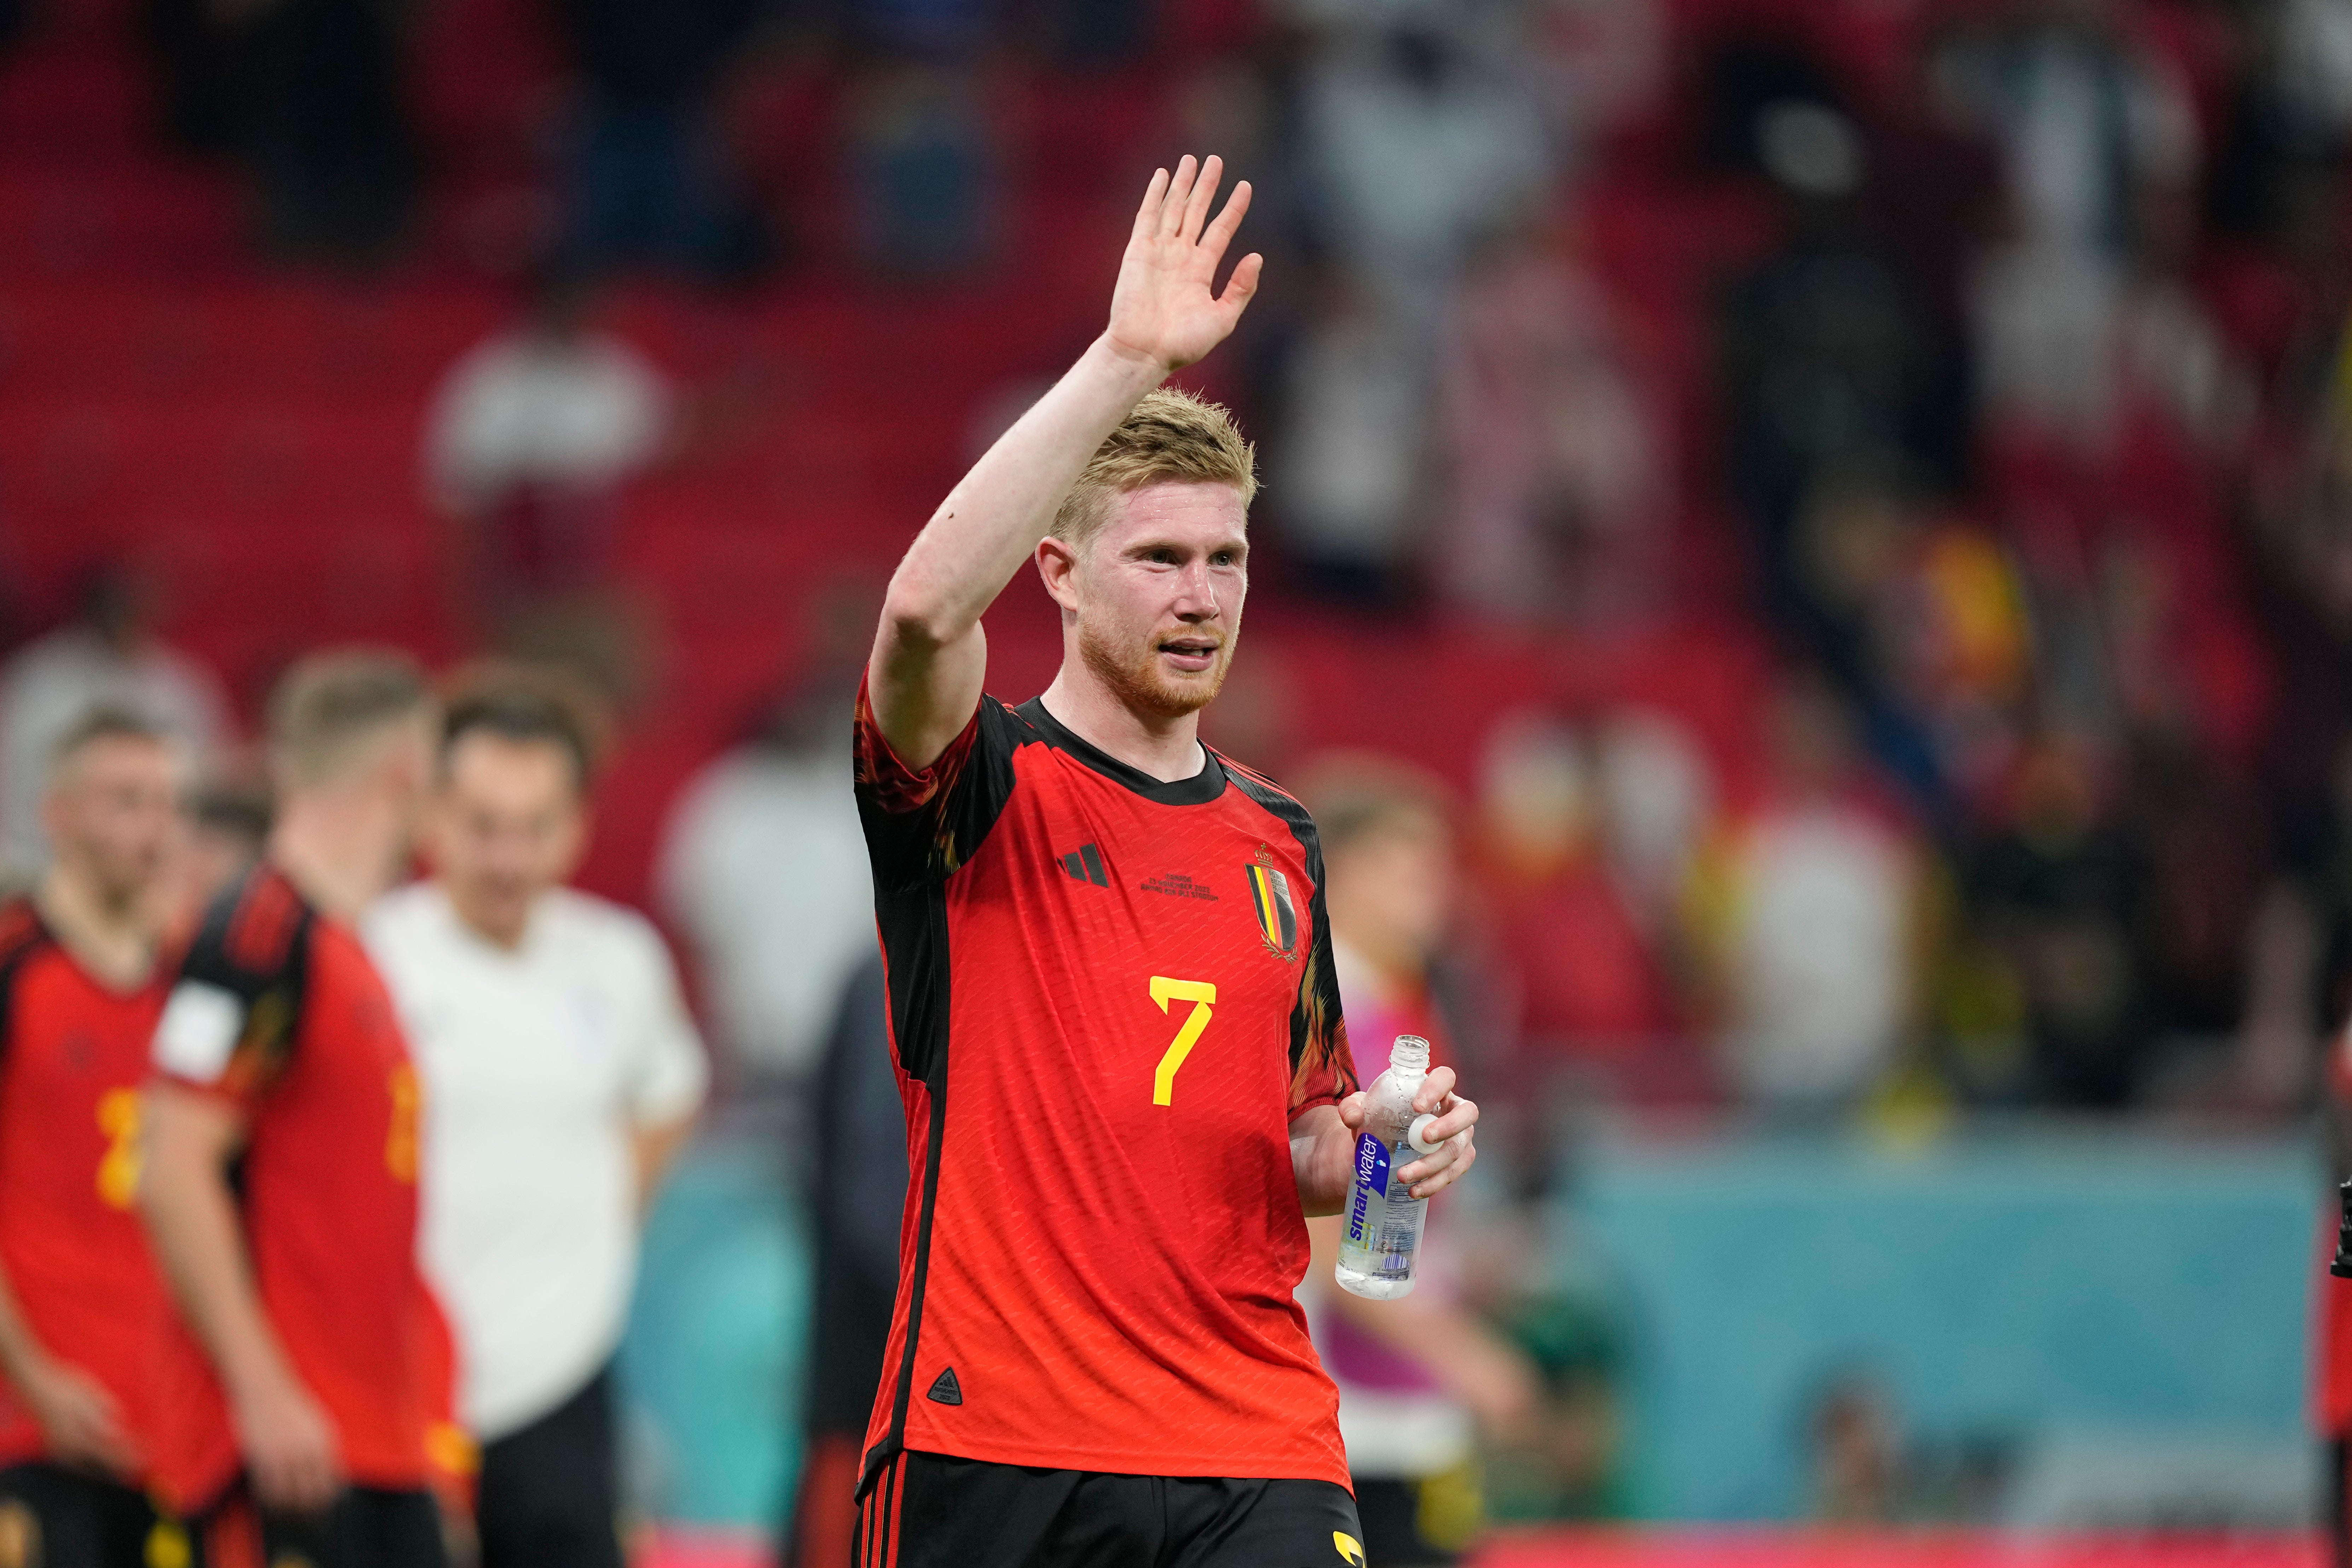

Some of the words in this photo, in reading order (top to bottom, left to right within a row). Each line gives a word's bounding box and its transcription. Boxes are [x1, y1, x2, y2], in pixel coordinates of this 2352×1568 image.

[1166, 874, 1192, 882] CANADA
[1195, 885, 1210, 893] 2022
[1149, 975, 1216, 1107] 7
